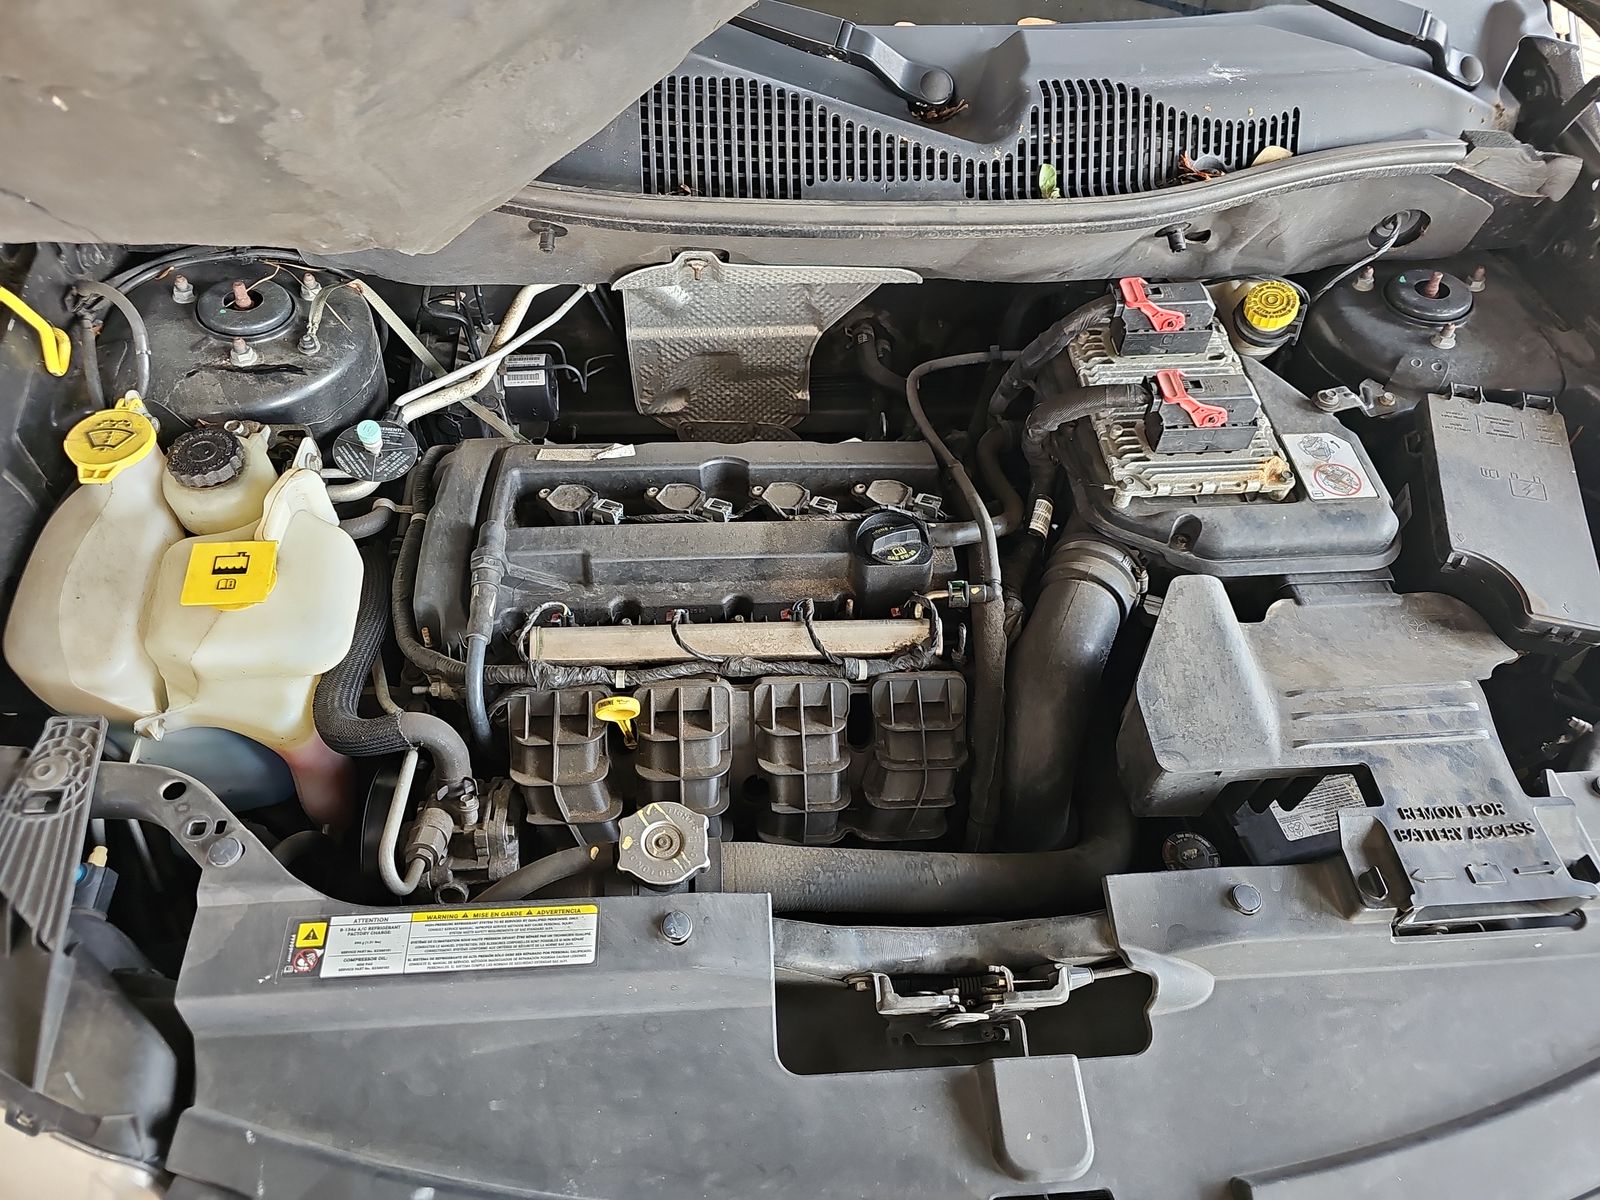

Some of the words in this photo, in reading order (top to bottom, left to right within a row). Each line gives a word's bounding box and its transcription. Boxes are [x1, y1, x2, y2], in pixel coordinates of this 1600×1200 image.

[1397, 804, 1468, 820] REMOVE
[1468, 802, 1506, 817] FOR
[1394, 826, 1464, 842] BATTERY
[1468, 822, 1536, 840] ACCESS
